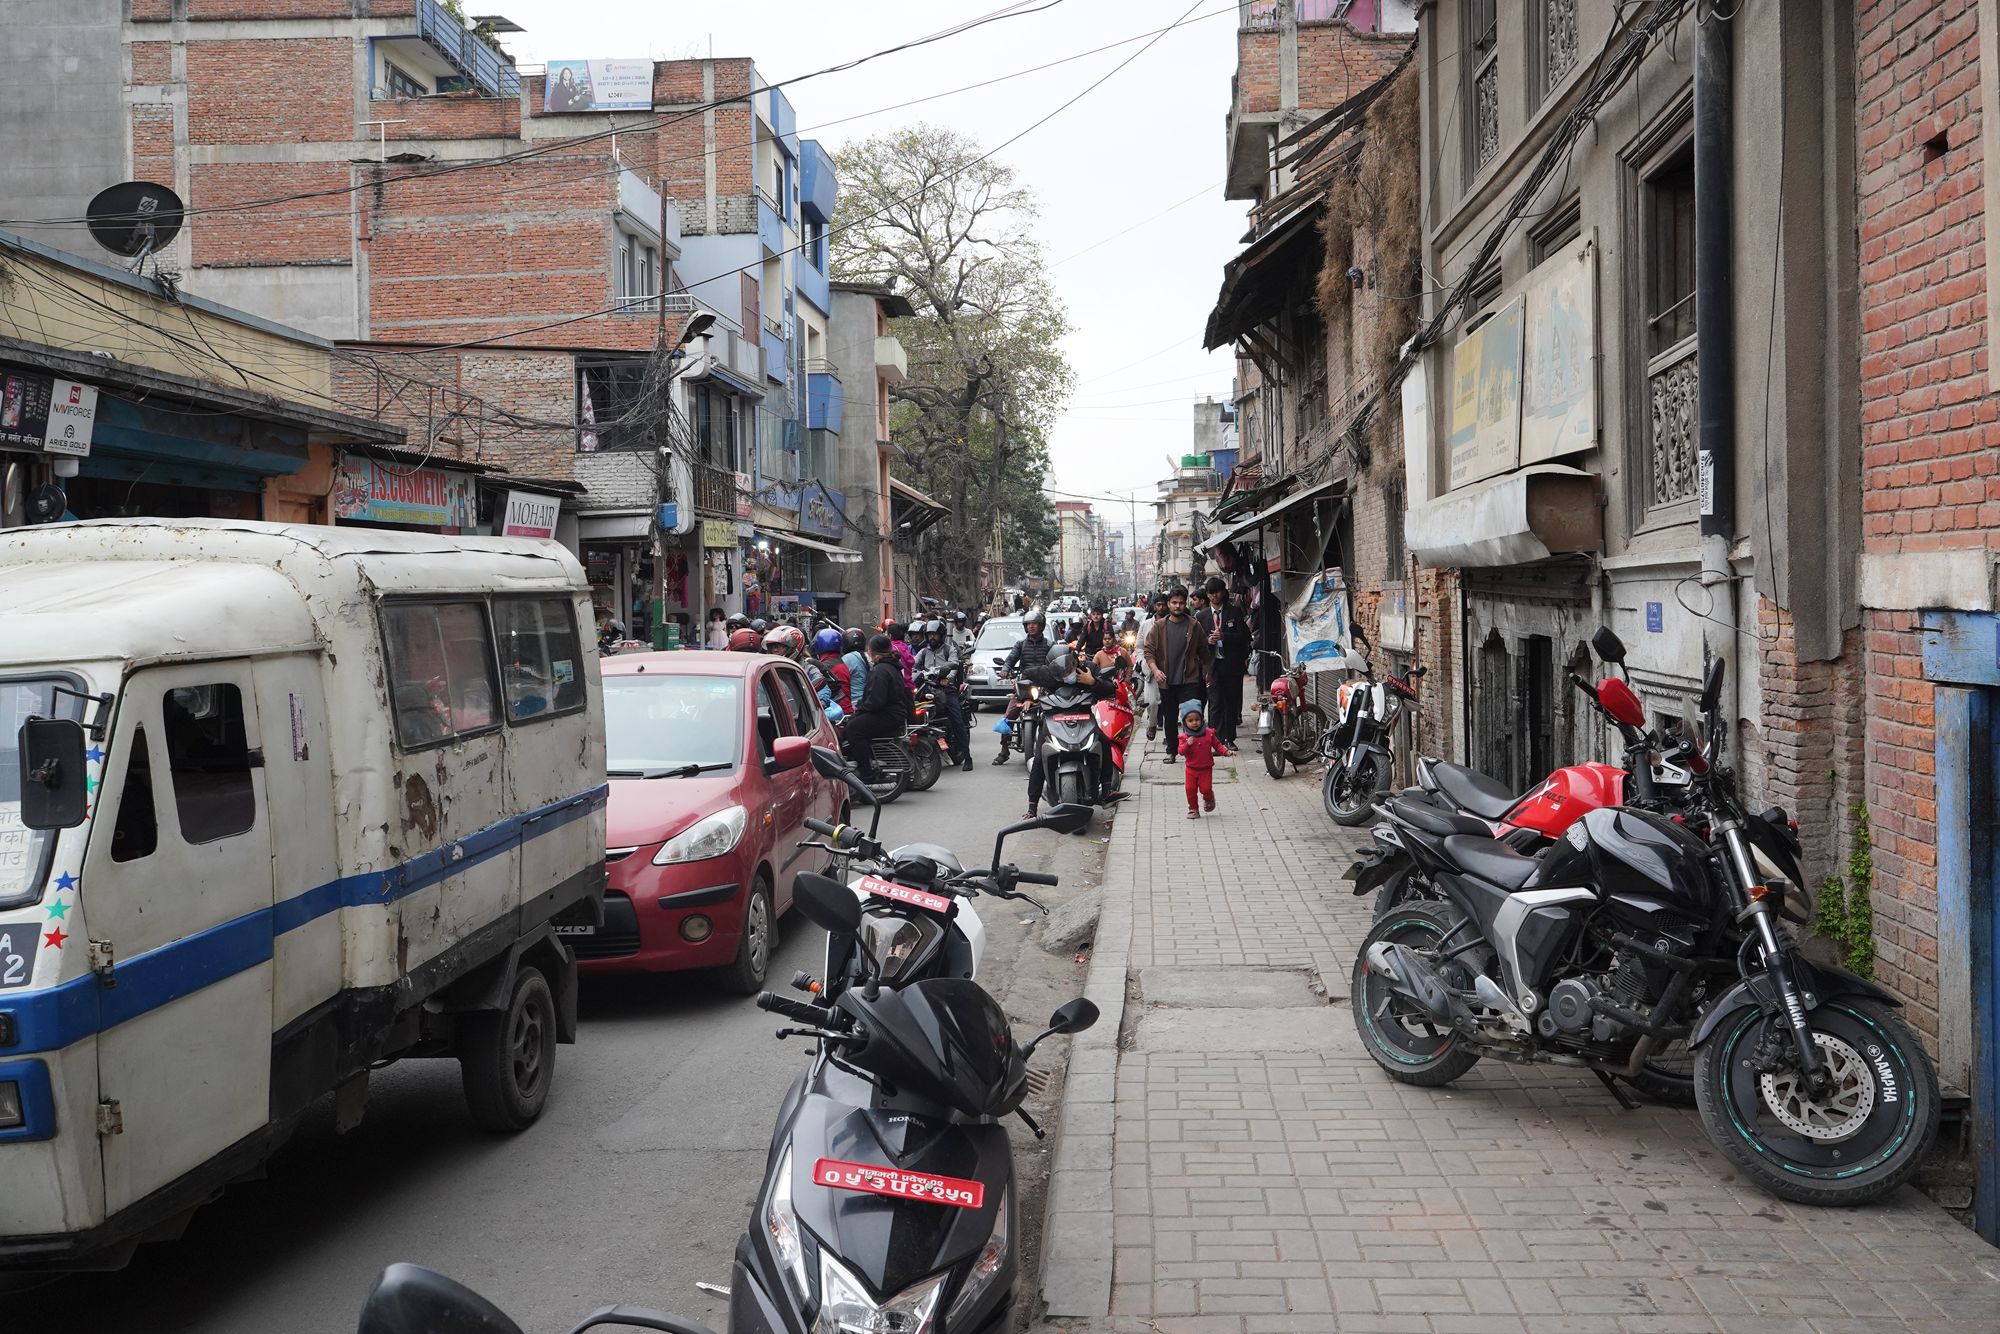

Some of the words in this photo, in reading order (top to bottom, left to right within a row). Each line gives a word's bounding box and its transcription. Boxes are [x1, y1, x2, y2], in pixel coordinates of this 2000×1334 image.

[53, 403, 92, 418] NAVIFORCE
[49, 438, 68, 447] ARIES
[69, 441, 87, 450] GOLD
[509, 501, 555, 527] MOHAIR
[1873, 1053, 1897, 1102] YAMAHA
[888, 1116, 926, 1129] HONDA
